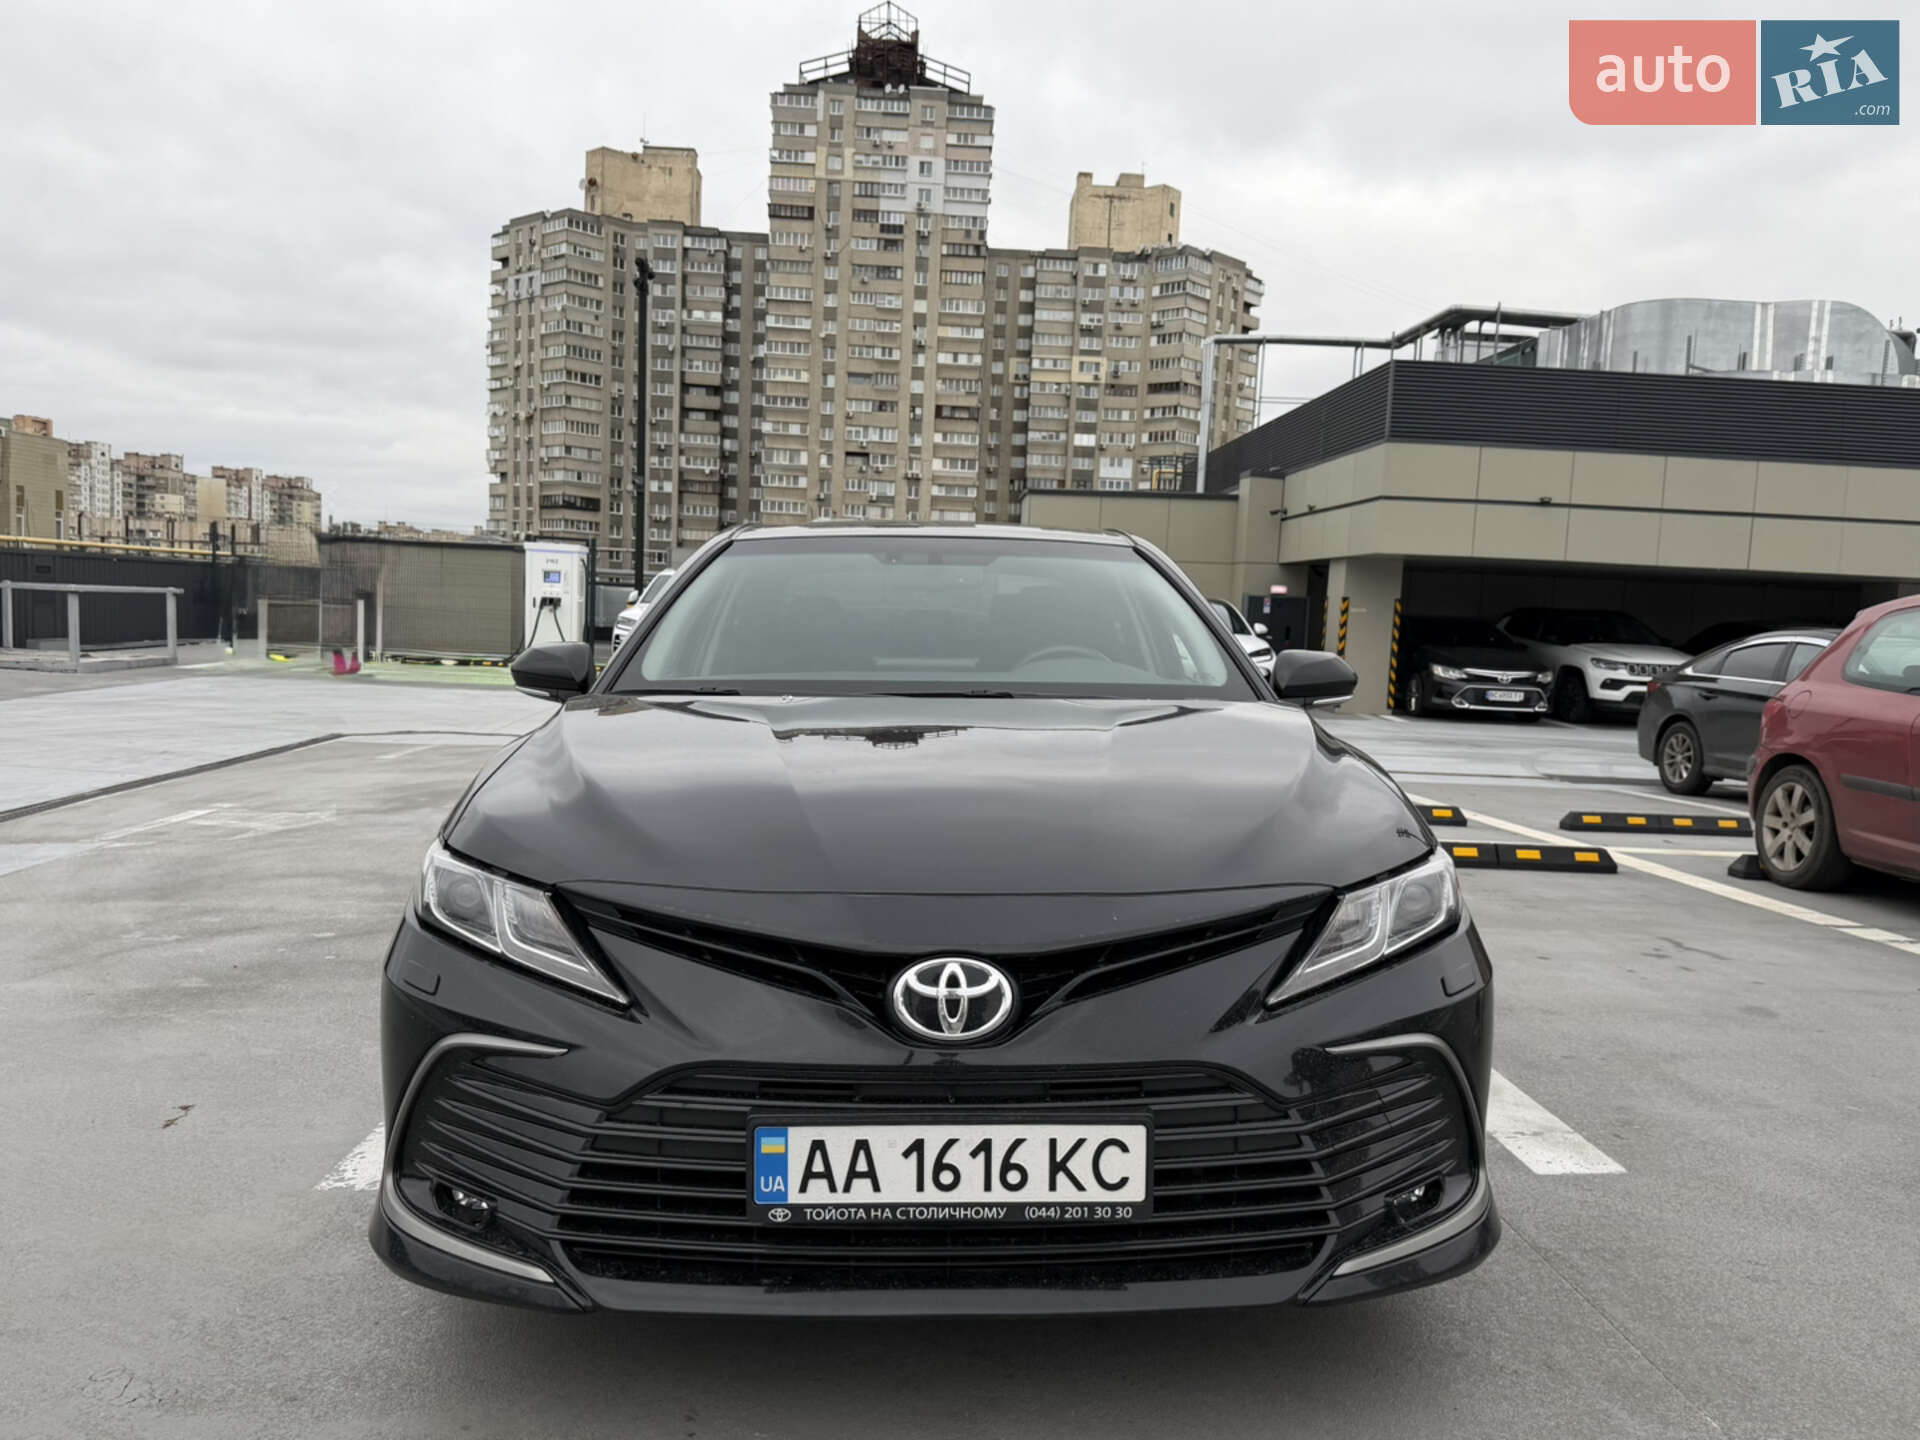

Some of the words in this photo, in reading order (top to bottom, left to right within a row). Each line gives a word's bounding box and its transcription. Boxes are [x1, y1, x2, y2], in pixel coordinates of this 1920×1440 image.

[798, 1139, 881, 1193] AA
[901, 1138, 1029, 1192] 1616
[1049, 1138, 1130, 1192] KC
[760, 1175, 786, 1192] UA
[804, 1206, 866, 1221] ТОЙОТА
[871, 1207, 892, 1220] НА
[896, 1206, 1007, 1220] СТОЛИЧНОМУ
[1024, 1206, 1061, 1219] (044)
[1064, 1206, 1088, 1218] 201
[1094, 1206, 1111, 1218] 30
[1115, 1206, 1132, 1218] 30
